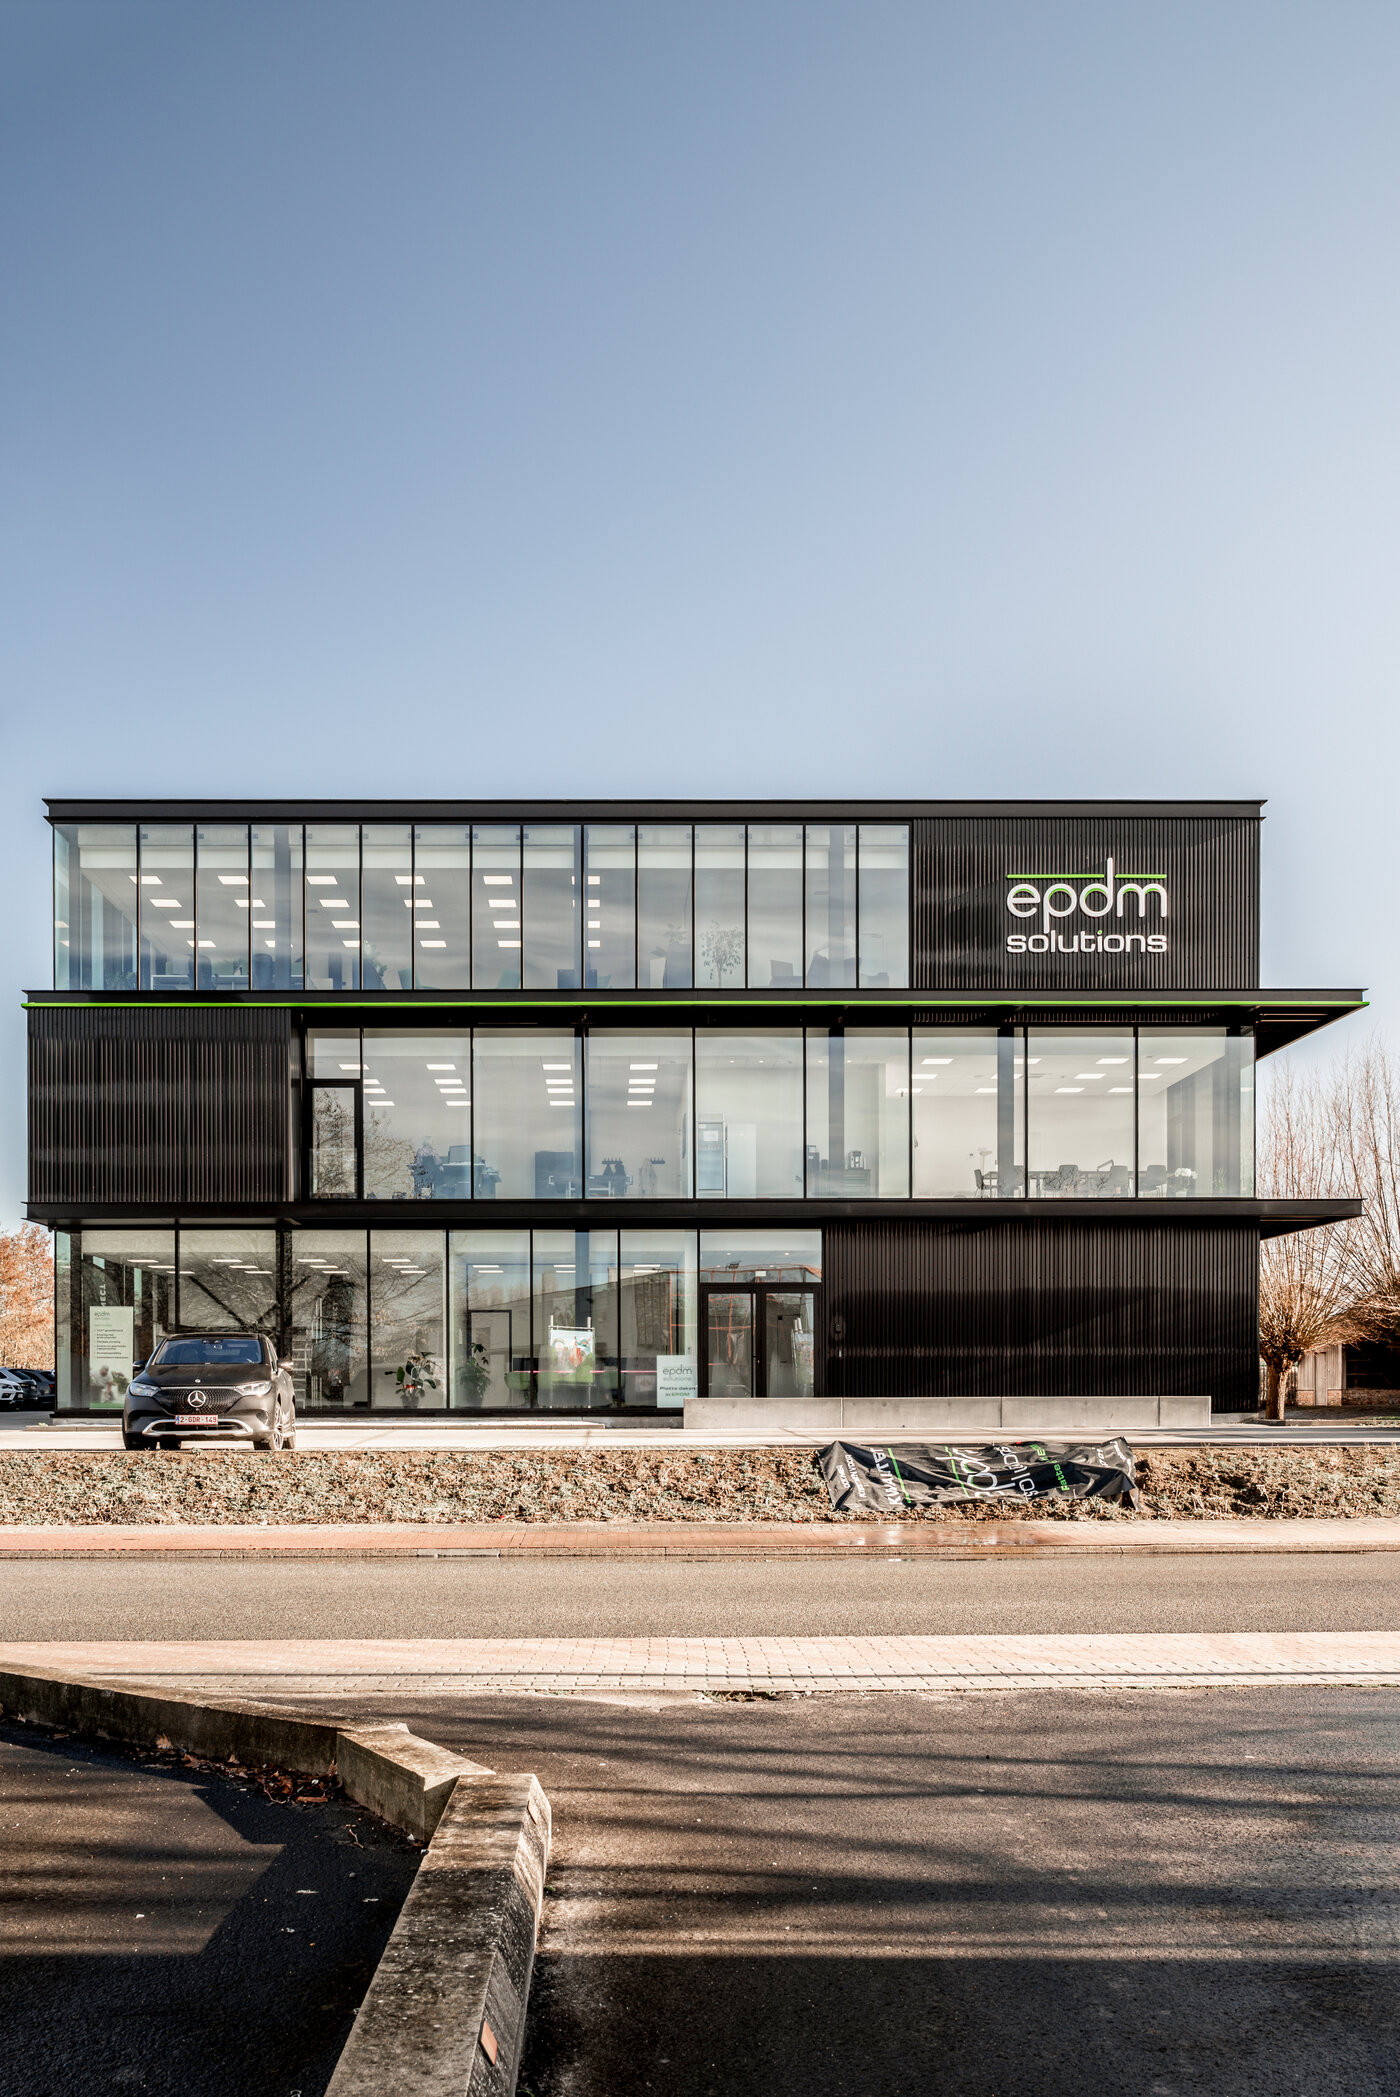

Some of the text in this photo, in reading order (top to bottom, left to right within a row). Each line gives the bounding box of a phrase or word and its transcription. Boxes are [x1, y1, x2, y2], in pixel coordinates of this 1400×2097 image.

[1007, 857, 1167, 934] epdm
[1007, 930, 1167, 952] solutions
[663, 1364, 692, 1378] epdm
